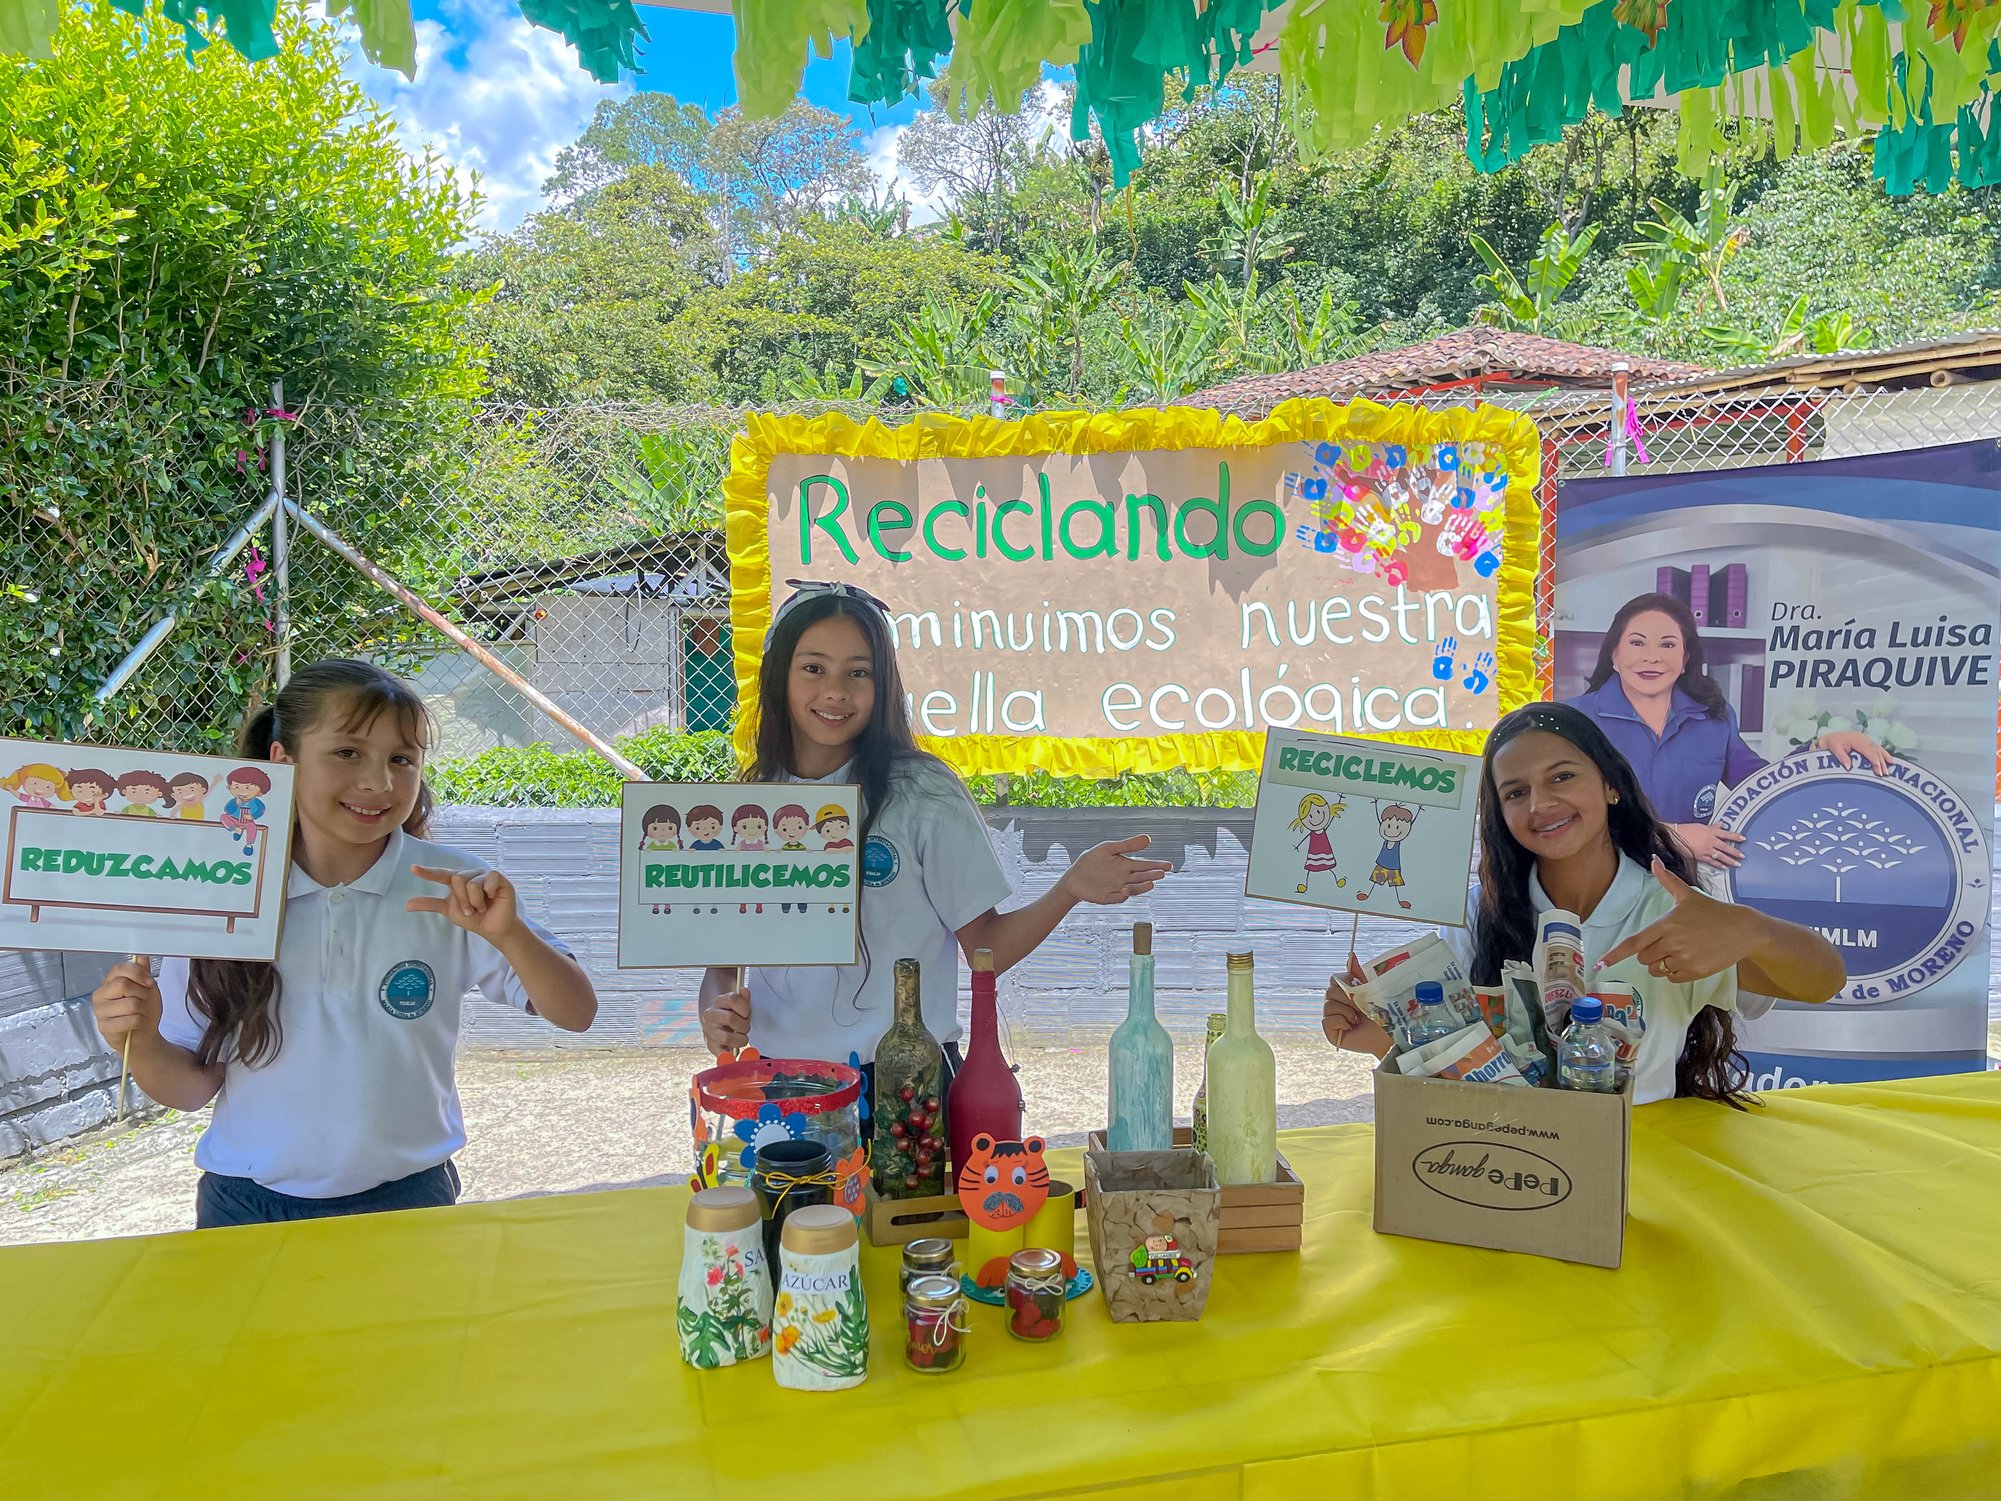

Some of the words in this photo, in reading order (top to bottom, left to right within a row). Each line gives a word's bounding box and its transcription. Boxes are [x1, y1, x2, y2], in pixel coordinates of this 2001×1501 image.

[798, 462, 1286, 566] Reciclando
[883, 600, 1176, 654] minuimos
[1242, 594, 1494, 649] nuestra
[1771, 602, 1822, 621] Dra.
[1769, 619, 1875, 652] María
[1887, 615, 1991, 648] Luisa
[1769, 655, 1991, 691] PIRAQUIVE
[905, 670, 1046, 737] ella
[1278, 746, 1457, 793] RECICLEMOS
[1720, 760, 1809, 831] UNDACIÓN
[20, 847, 252, 885] REDUZCAMOS
[645, 863, 850, 888] REUTILICEMOS
[1852, 984, 1880, 1000] de
[1885, 920, 1975, 993] MORENO
[1426, 1117, 1560, 1140] www.pepeganga.com
[782, 1274, 849, 1291] AZÚCAR
